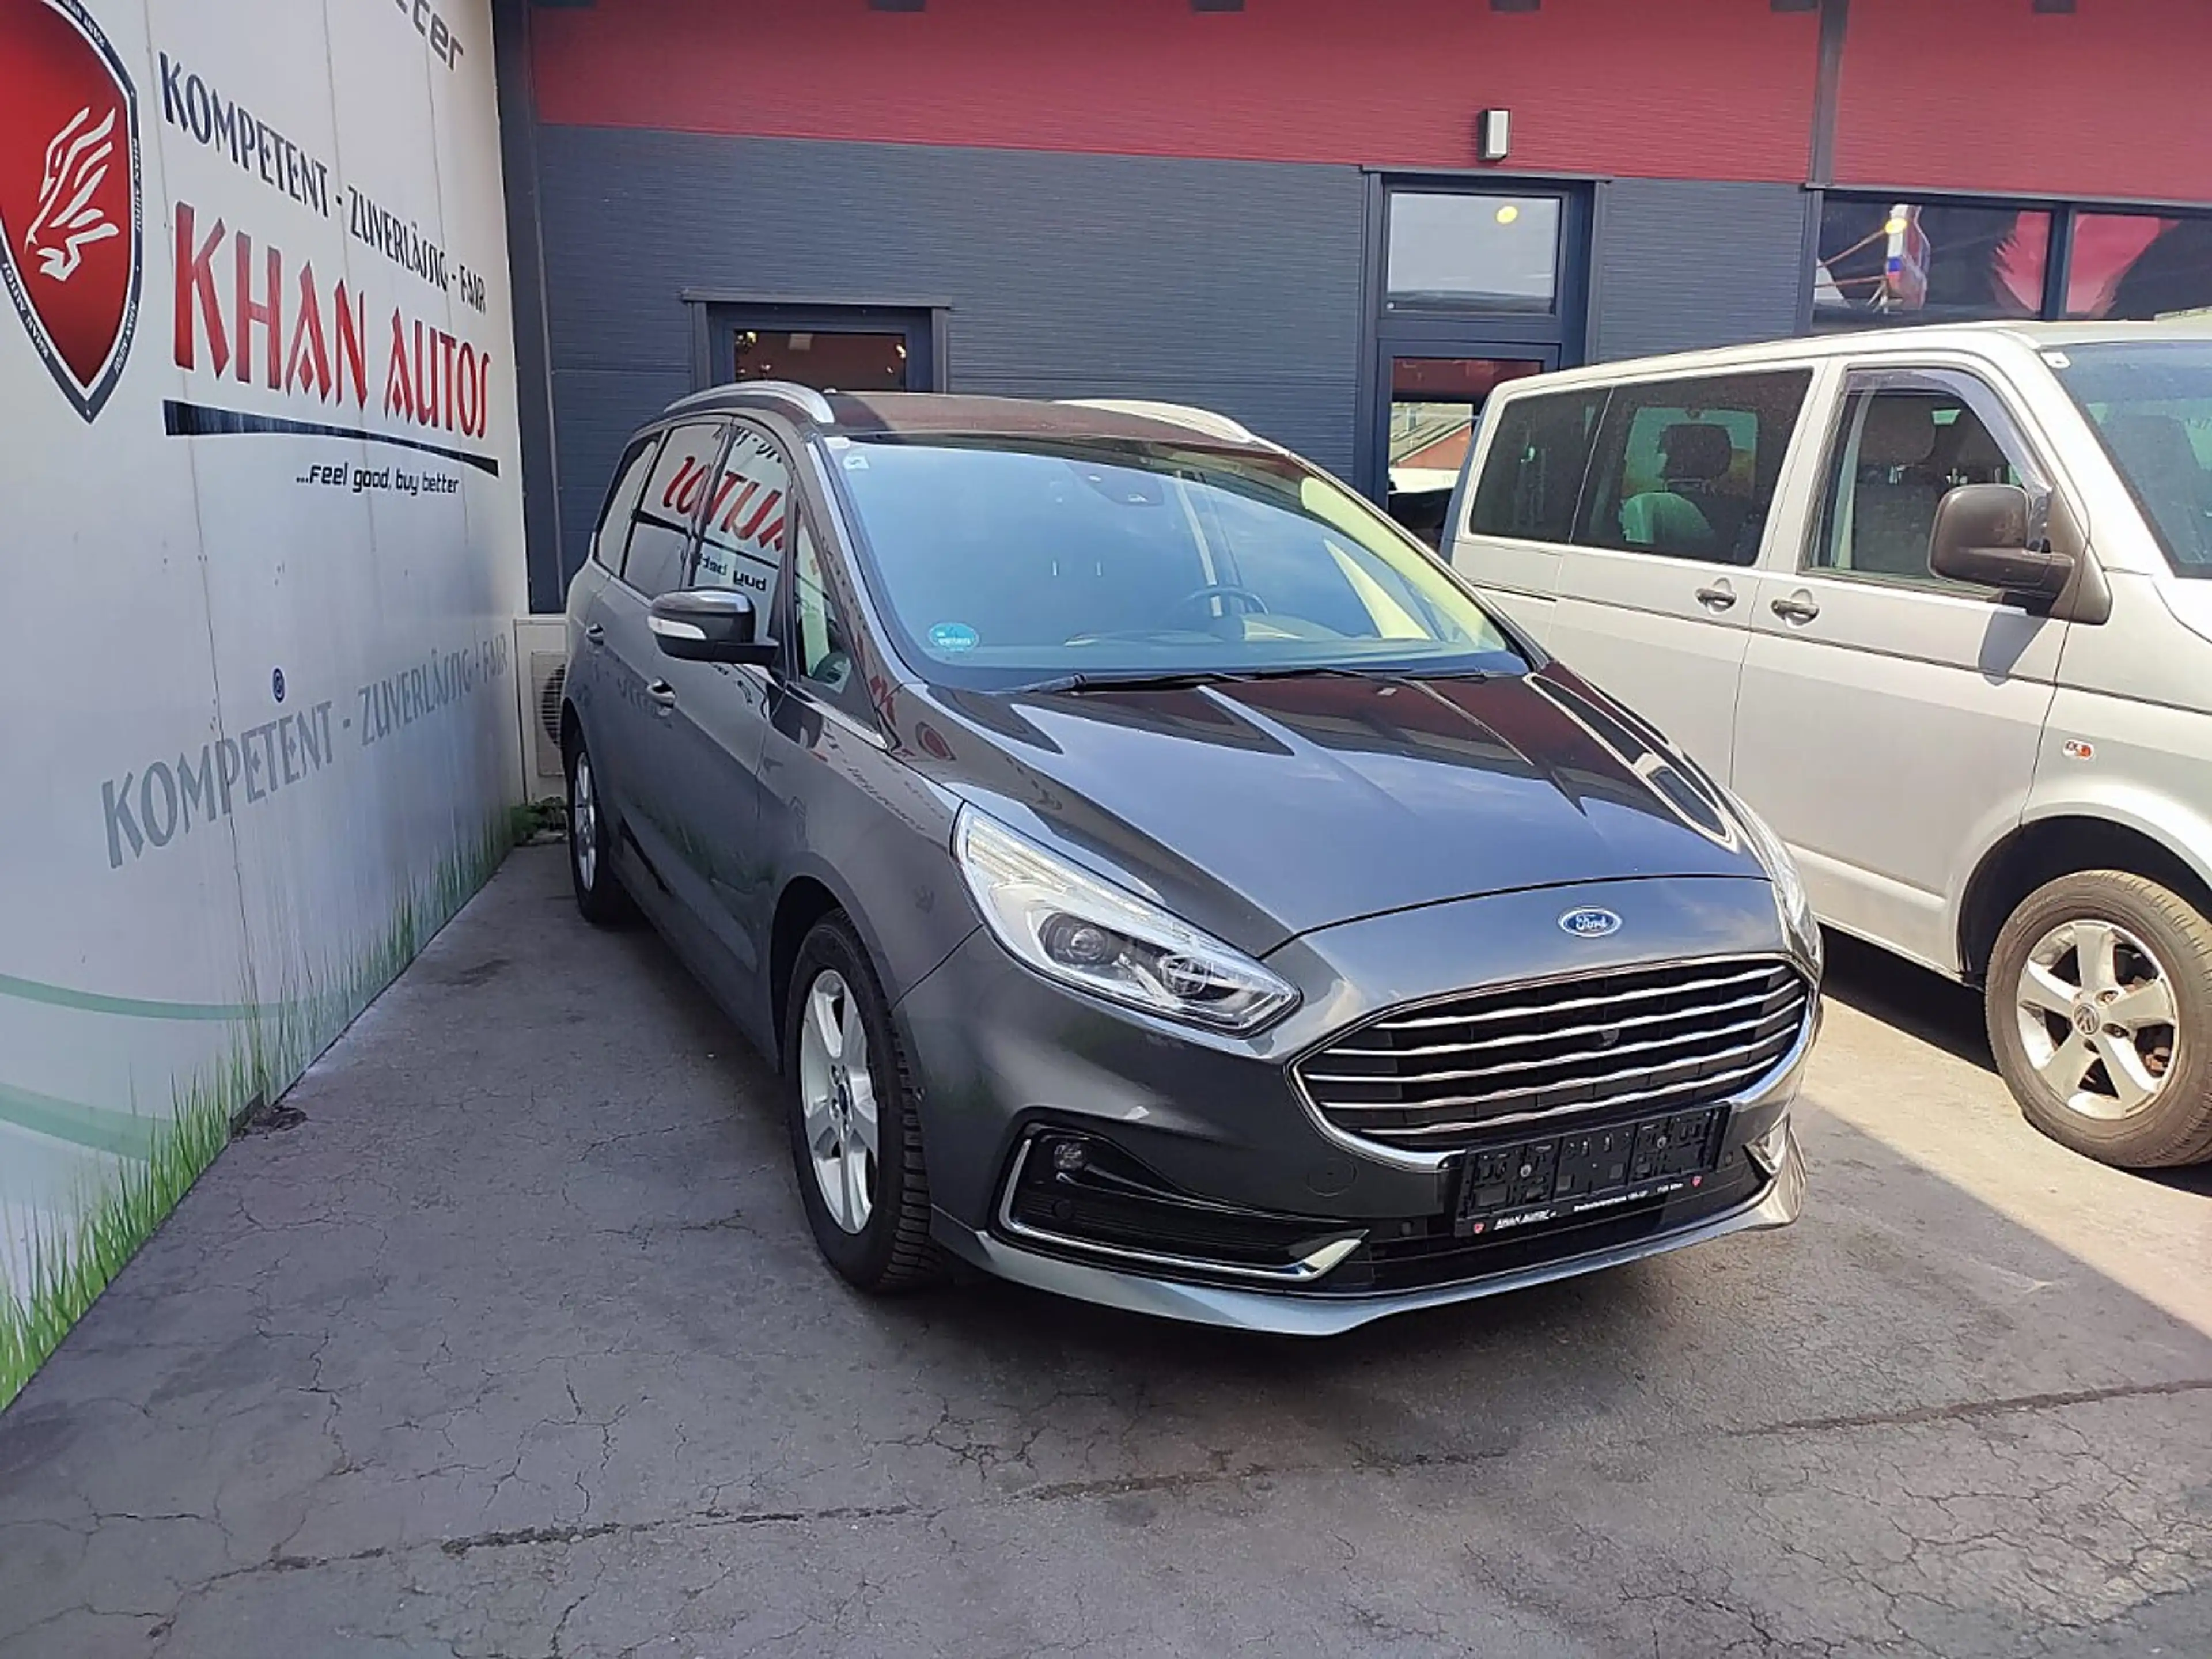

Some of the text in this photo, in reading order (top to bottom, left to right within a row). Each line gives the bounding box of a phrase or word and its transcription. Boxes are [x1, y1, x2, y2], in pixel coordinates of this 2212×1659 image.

[159, 50, 328, 218] KOMPETENT
[459, 263, 486, 315] FAIR
[174, 200, 368, 412] KHAN
[384, 306, 491, 439] AUTOS
[396, 468, 419, 496] buy
[421, 471, 459, 494] better
[101, 700, 333, 869] KOMPETENT
